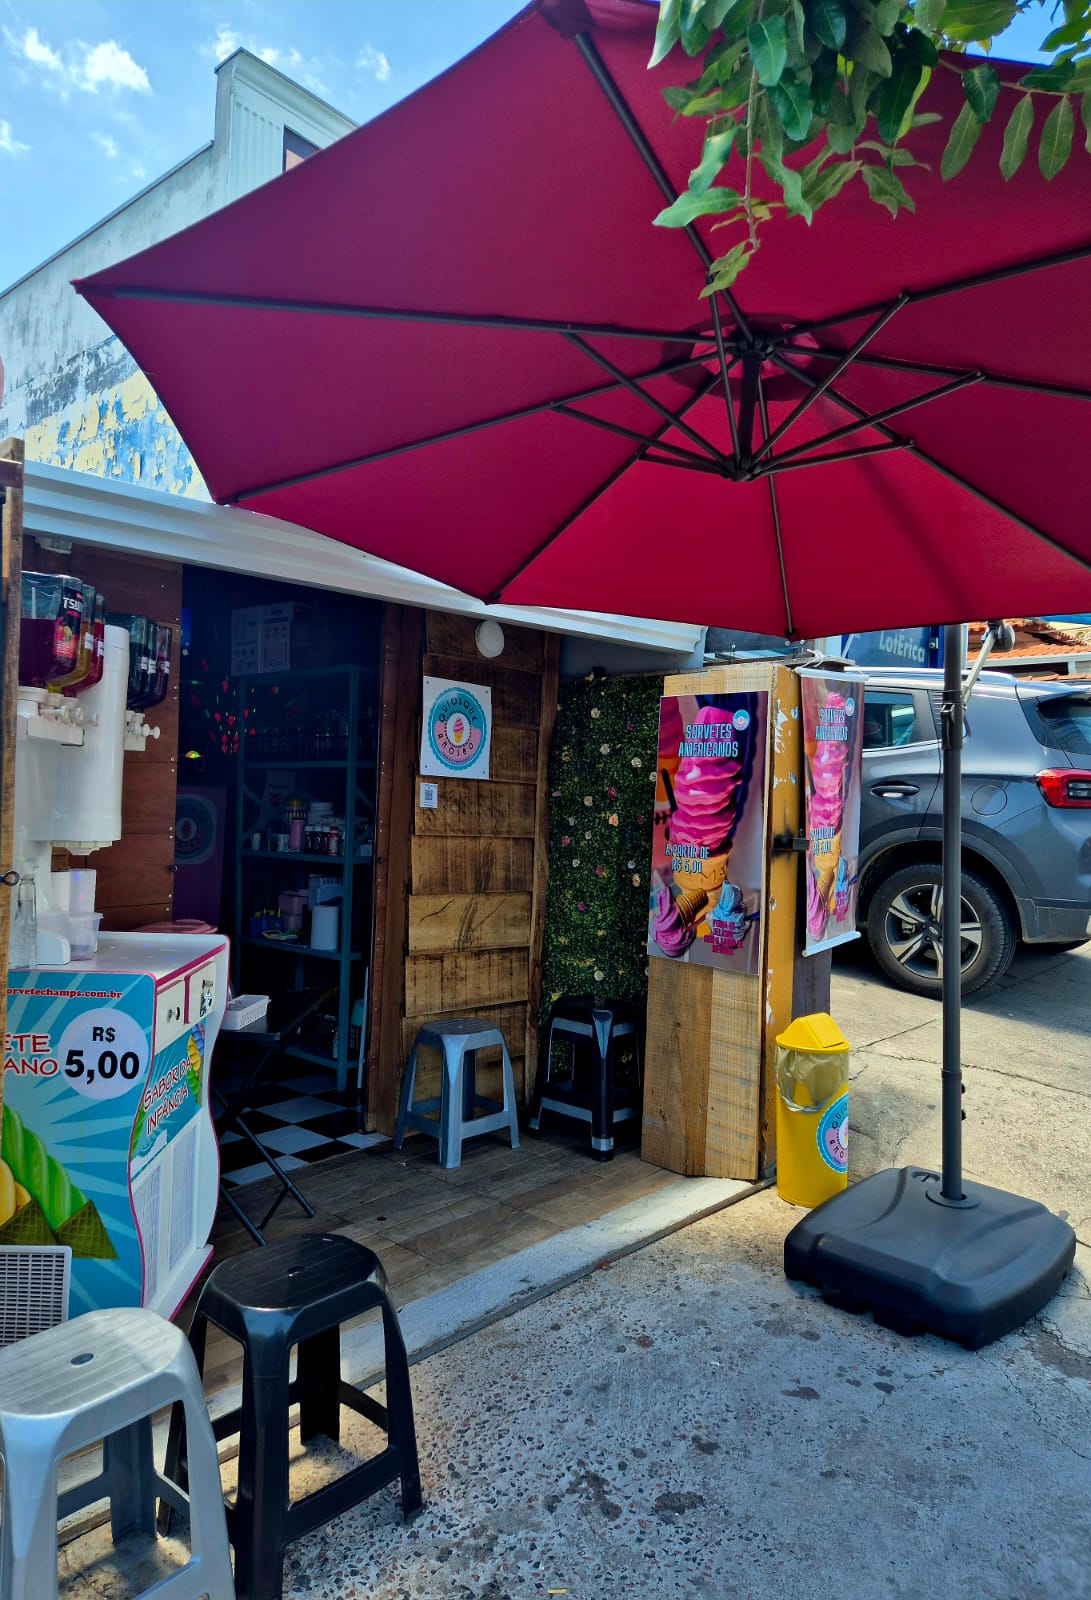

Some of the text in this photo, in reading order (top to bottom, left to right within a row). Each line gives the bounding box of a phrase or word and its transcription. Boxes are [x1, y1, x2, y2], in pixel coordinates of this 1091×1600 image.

[685, 723, 732, 740] SORVETES
[678, 741, 739, 758] AMERICANOS
[92, 1026, 116, 1043] R$
[64, 1049, 140, 1084] 5,00
[144, 1056, 193, 1111] SABOR DA
[147, 1083, 188, 1134] INFÂNCIA
